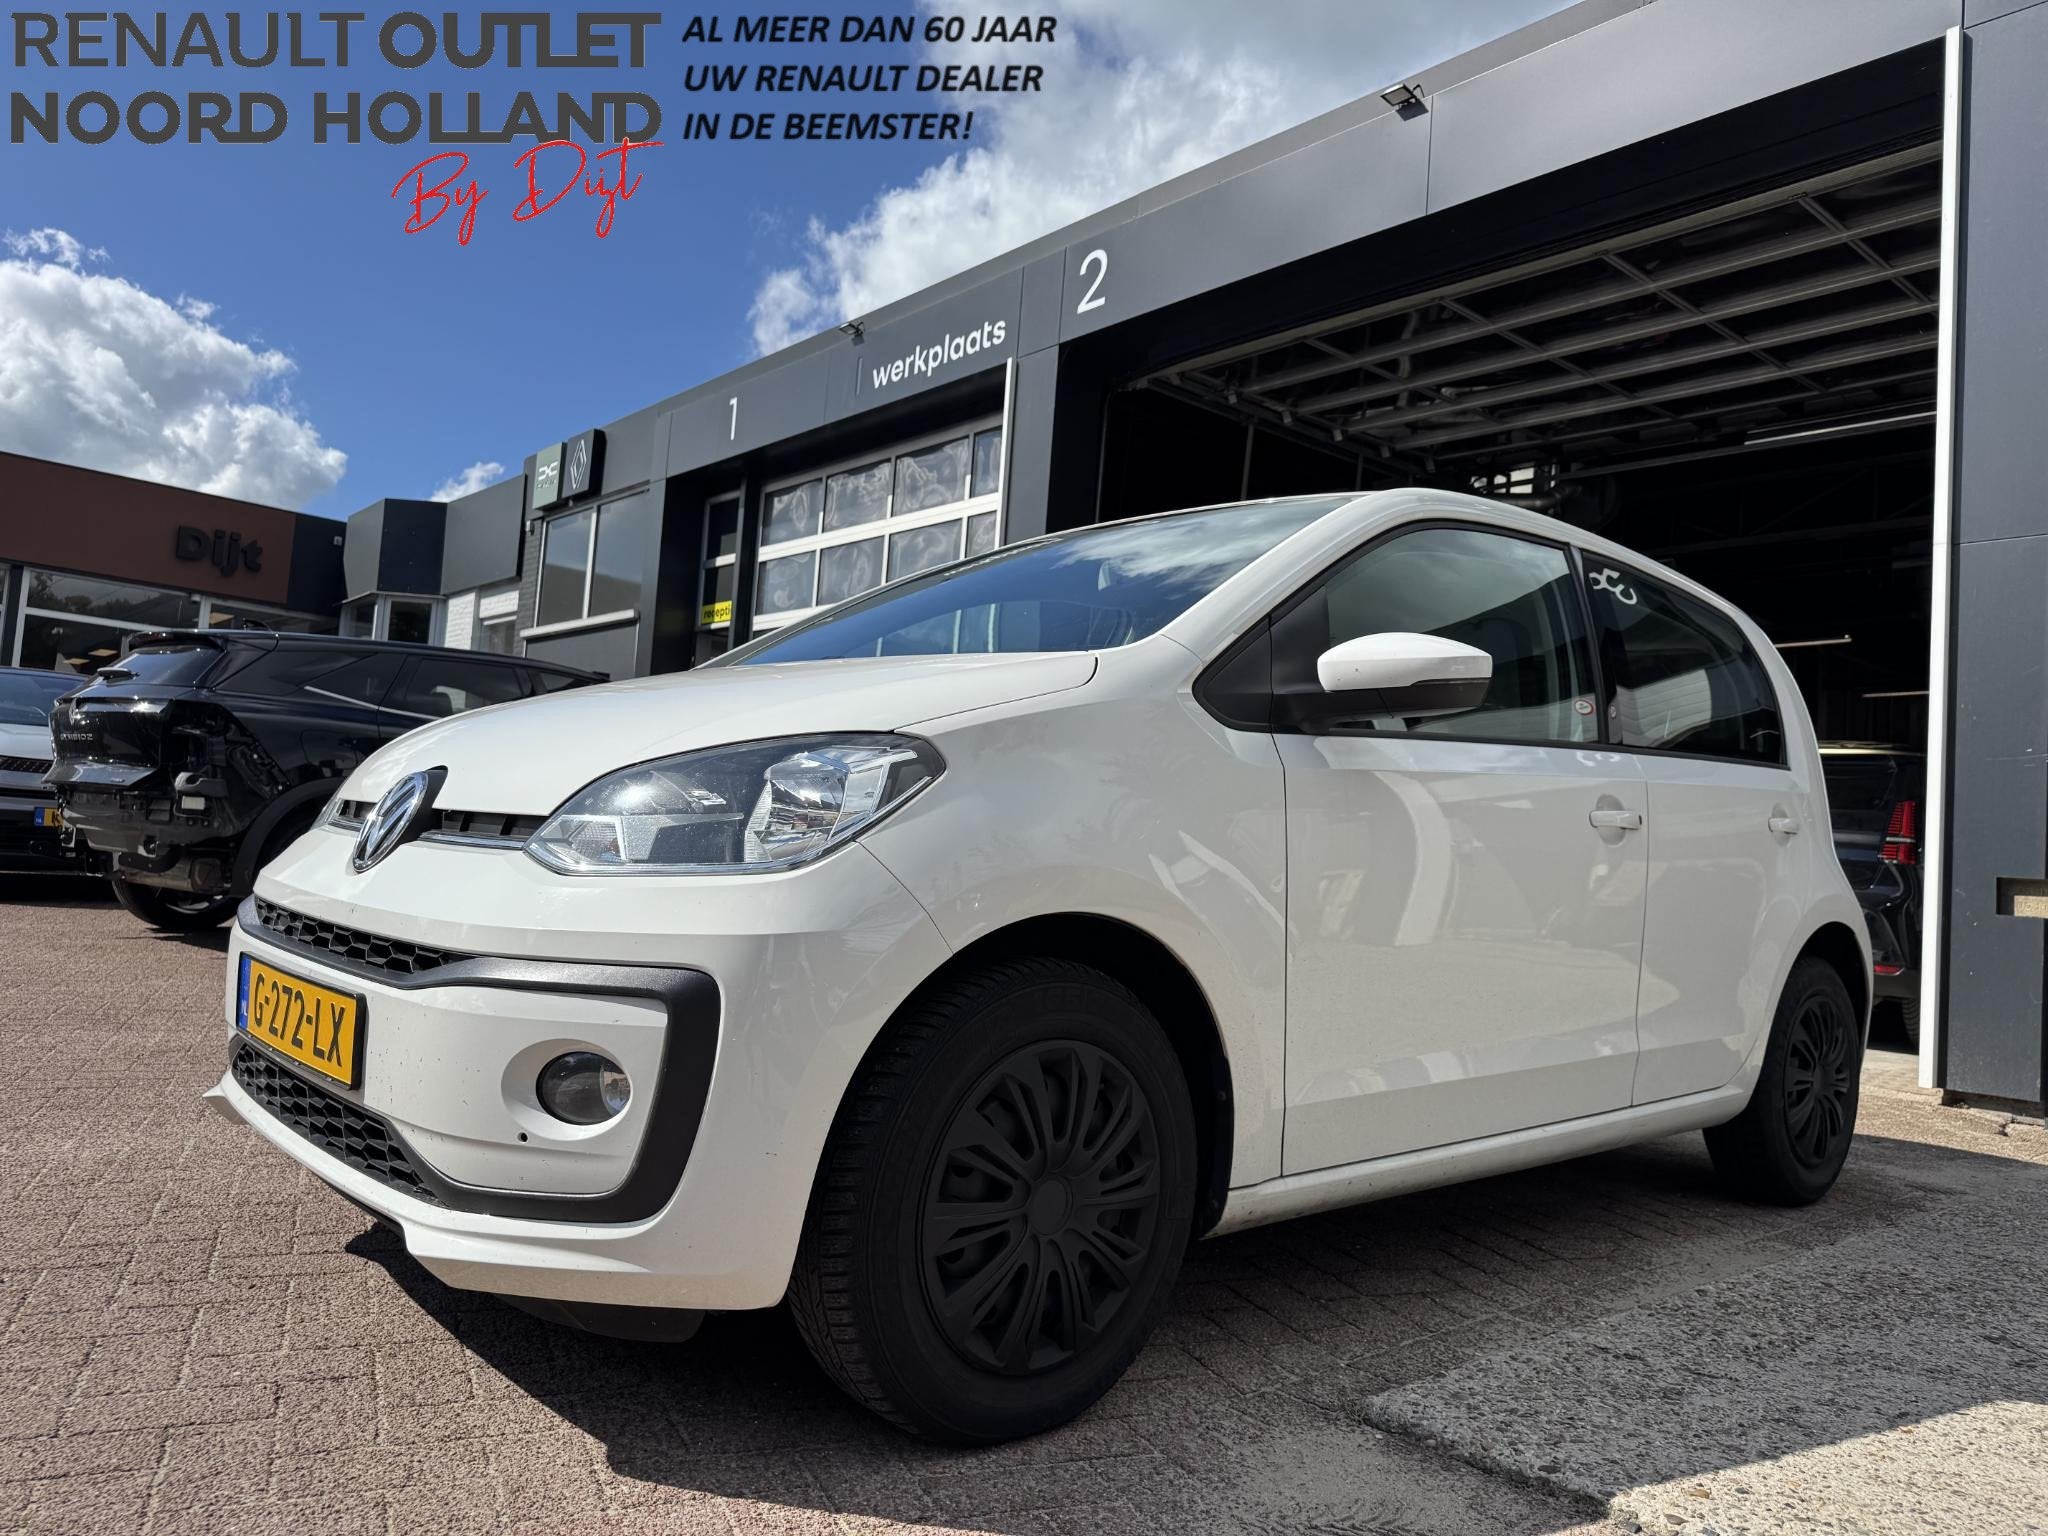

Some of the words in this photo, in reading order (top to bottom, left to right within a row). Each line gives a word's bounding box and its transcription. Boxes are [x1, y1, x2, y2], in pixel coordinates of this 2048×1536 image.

[1077, 249, 1108, 314] 2
[872, 320, 1006, 389] werkplaats
[729, 396, 738, 441] 1
[175, 525, 263, 577] Dijt
[253, 972, 346, 1068] G-272-LX
